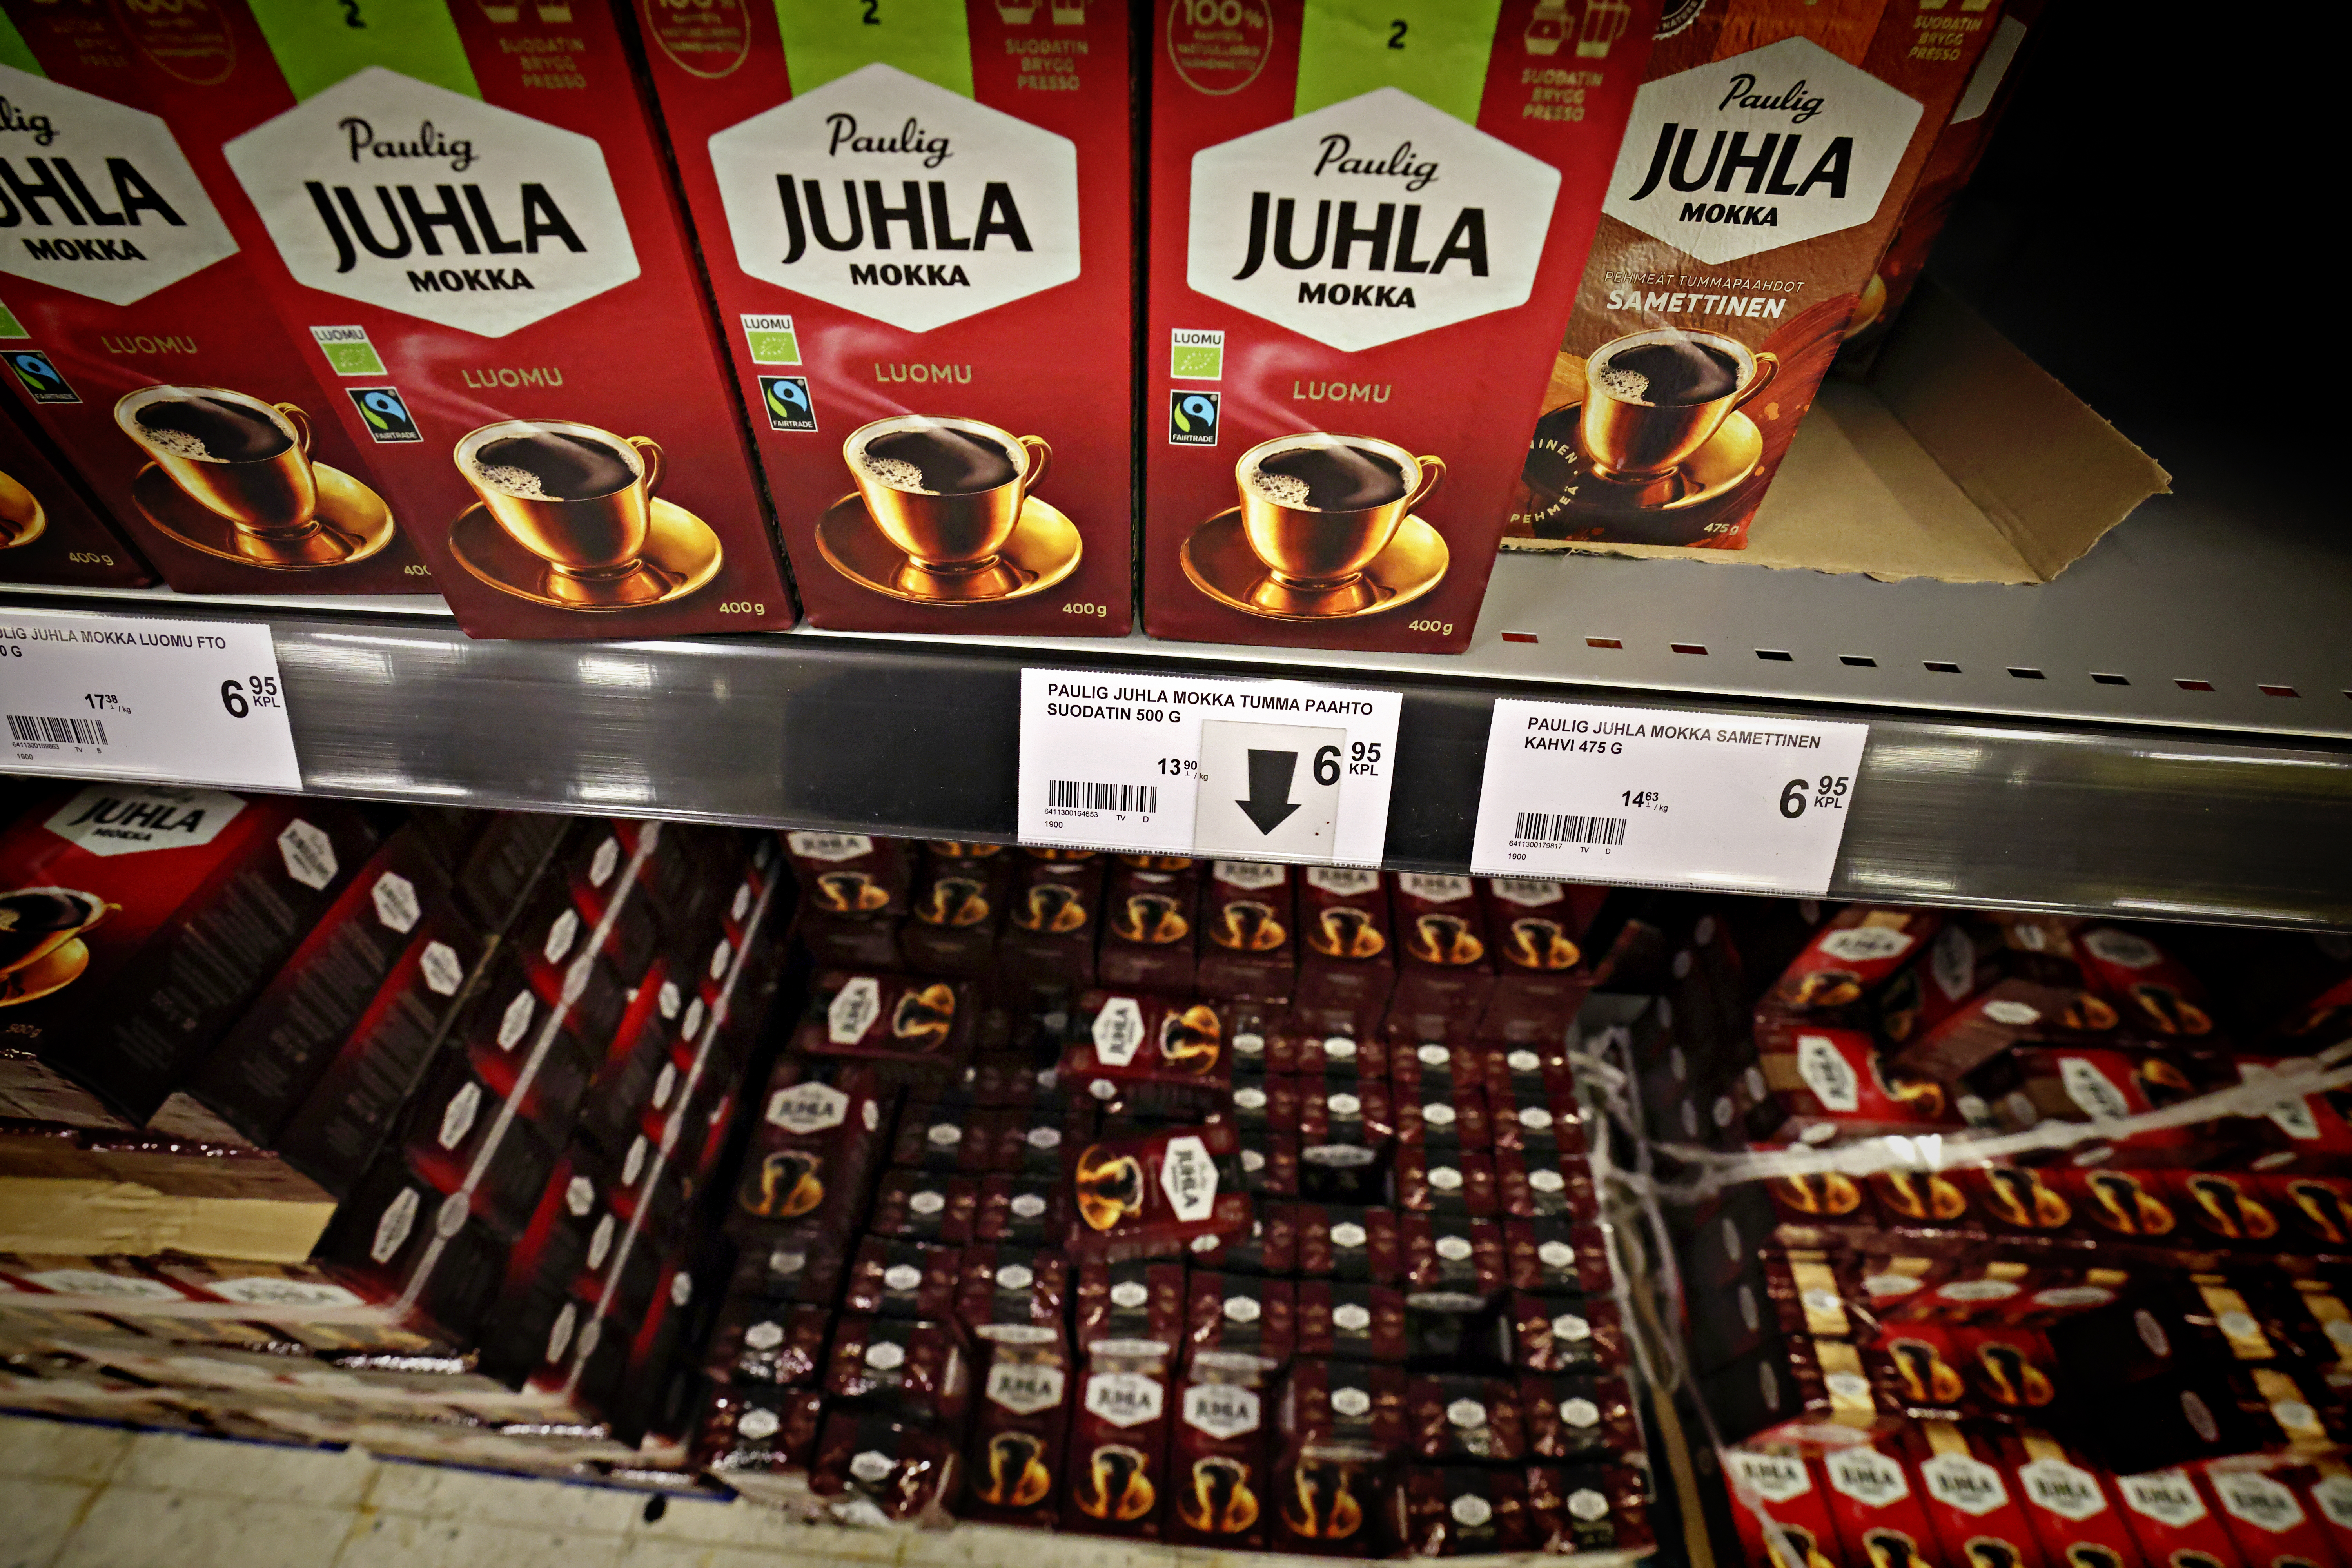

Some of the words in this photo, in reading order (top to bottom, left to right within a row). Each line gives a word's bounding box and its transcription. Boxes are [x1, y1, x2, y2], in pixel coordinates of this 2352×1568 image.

[1387, 19, 1408, 50] 2
[1913, 16, 1983, 31] SUODATIN
[1005, 39, 1089, 54] SUODATIN
[1719, 73, 1824, 123] Paulig
[339, 116, 479, 172] Paulig
[826, 113, 953, 168] Paulig
[1314, 134, 1439, 191] Paulig
[1629, 123, 1853, 201] JUHLA
[776, 174, 1033, 264] JUHLA
[1679, 203, 1777, 226] MOKKA
[304, 181, 587, 273] JUHLA
[1233, 192, 1488, 280] JUHLA
[22, 238, 147, 261] MOKKA
[407, 269, 535, 292] MOKKA
[850, 264, 970, 286] MOKKA
[1604, 271, 1674, 286] PEHMEÄT
[1680, 276, 1804, 292] TUMMAPAAHDOT
[1299, 282, 1415, 308] MOKKA
[1607, 290, 1786, 318] SAMETTINEN
[744, 319, 790, 329] LUOMU
[101, 336, 198, 354] LUOMU
[315, 330, 364, 341] LUOMU
[1175, 333, 1221, 344] LUOMU
[462, 368, 563, 388] LUOMU
[875, 363, 971, 384] LUOMU
[1294, 381, 1391, 403] LUOMU
[1172, 434, 1213, 442] FAIRTRADE
[1510, 486, 1579, 523] PEHMEÄ
[31, 628, 78, 642] JUHLA
[81, 631, 137, 645] MOKKA
[140, 633, 192, 647] LUOMU
[197, 636, 226, 649] FTO
[11, 646, 22, 657] G
[253, 696, 280, 708] KPL
[1049, 684, 1108, 699] PAULIG
[1114, 688, 1168, 703] JUHLA
[1174, 691, 1235, 707] MOKKA
[1240, 695, 1300, 711] TUMMA
[1305, 699, 1373, 715] PAAHTO
[1047, 703, 1131, 720] SUODATIN
[1136, 709, 1163, 722] 500
[1169, 711, 1180, 723] G
[1528, 717, 1588, 733] PAULIG
[1593, 722, 1645, 737] JUHLA
[1651, 725, 1711, 741] MOKKA
[1717, 730, 1821, 749] SAMETTINEN
[1525, 737, 1574, 751] KAHVI
[1579, 741, 1606, 753] 475
[1611, 742, 1622, 755] G
[1314, 746, 1341, 786] 6
[1352, 742, 1381, 762] 95
[1349, 763, 1378, 776] KPL
[1780, 779, 1809, 818] 6
[1818, 776, 1849, 796] 95
[1814, 796, 1842, 808] KPL
[67, 798, 205, 832] JUHLA
[1045, 808, 1098, 817] 6411300164653
[1509, 840, 1563, 849] 6411300179817
